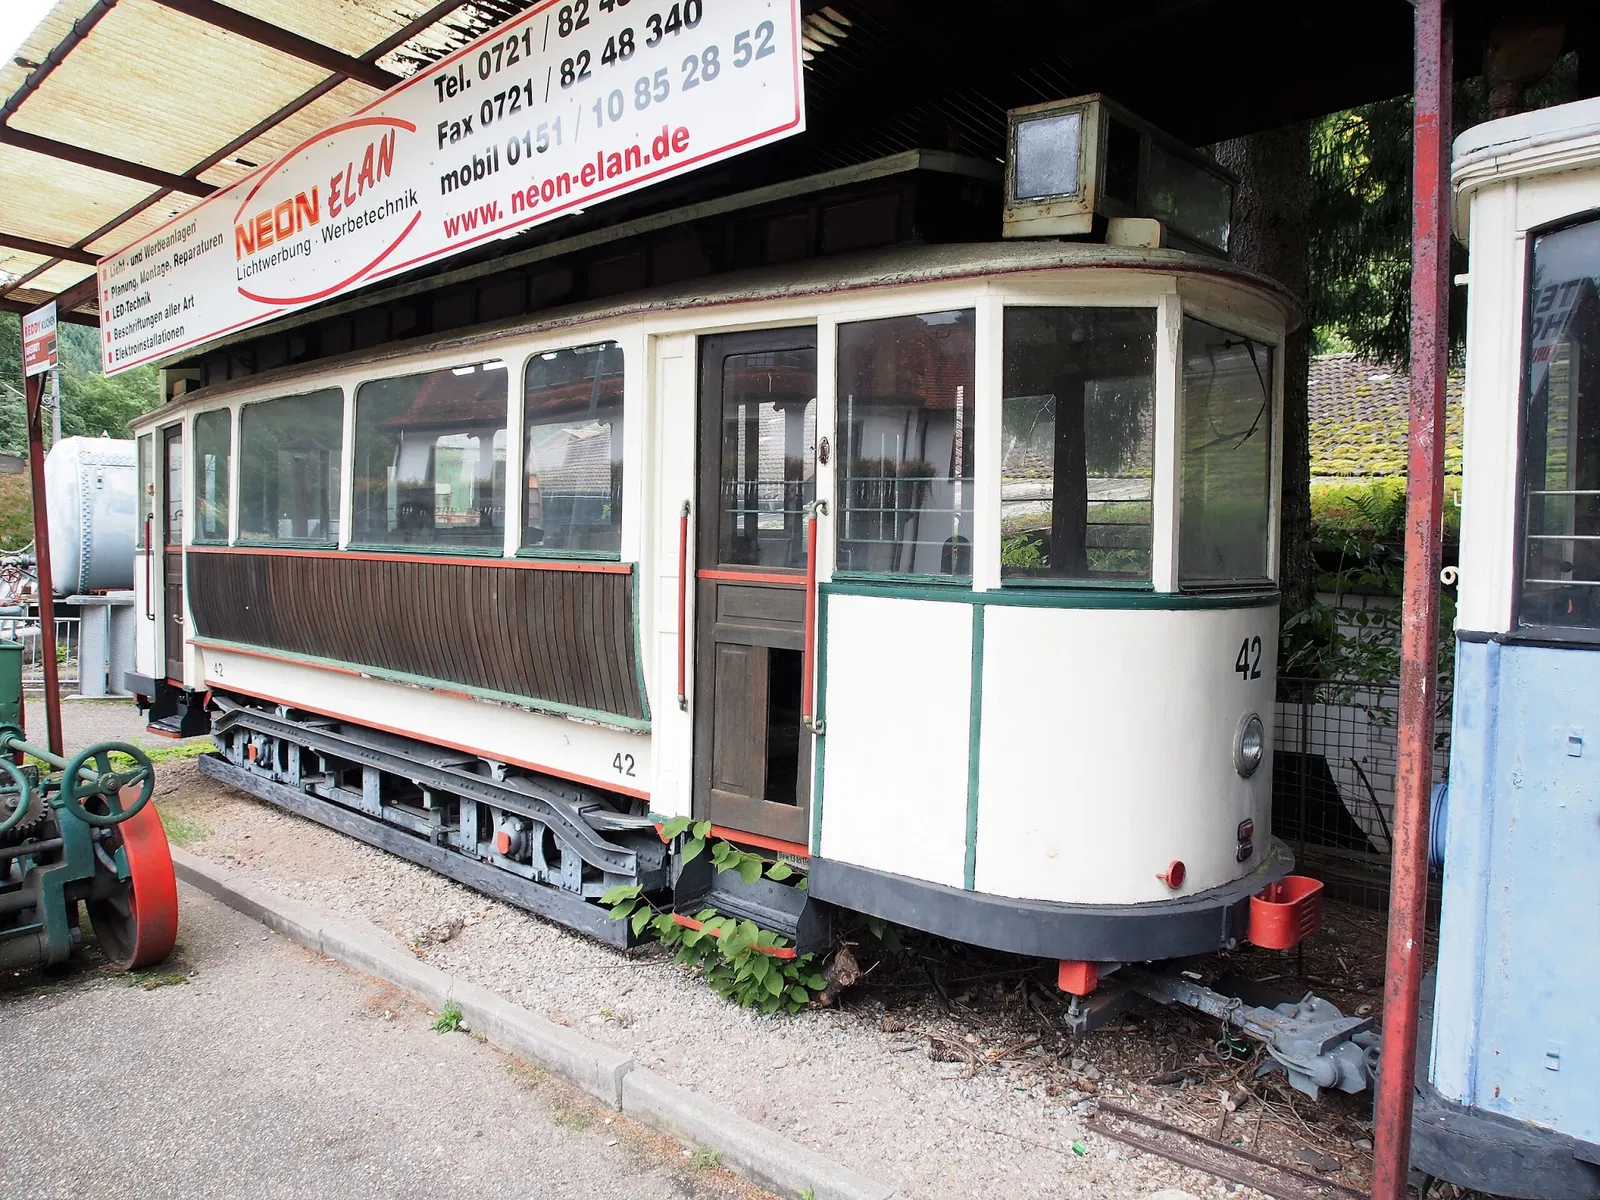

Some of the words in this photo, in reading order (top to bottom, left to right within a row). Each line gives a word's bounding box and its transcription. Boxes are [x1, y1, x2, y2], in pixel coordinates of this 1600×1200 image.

[434, 63, 471, 103] Tel.
[478, 27, 533, 80] 0721
[543, 15, 550, 52] /
[558, 0, 590, 38] 82
[437, 114, 474, 150] Fax
[480, 79, 534, 128] 0721
[545, 66, 551, 103] /
[560, 49, 592, 90] 82
[601, 27, 636, 67] 48
[645, 0, 703, 48] 340
[440, 145, 499, 195] mobil
[506, 116, 563, 166] 0151
[575, 105, 582, 142] /
[592, 88, 624, 129] 10
[634, 67, 670, 111] 85
[681, 45, 721, 92] 28
[733, 20, 776, 68] 52
[234, 185, 320, 261] NEON
[328, 127, 396, 219] ELAN
[130, 250, 143, 267] und
[144, 222, 197, 260] Werbeanlagen
[236, 238, 311, 281] Lichtwerbung
[321, 188, 419, 244] Werbetechnik
[111, 278, 139, 299] Planung,
[140, 260, 172, 285] Montage,
[173, 233, 224, 267] Reparaturen
[112, 291, 152, 320] LED-Technik
[114, 310, 163, 341] Beschriftungen
[165, 302, 181, 319] aller
[183, 294, 195, 311] Art
[115, 325, 185, 361] Elektroinstallationen
[213, 662, 224, 677] 42
[1235, 635, 1262, 681] 42
[612, 752, 636, 777] 42
